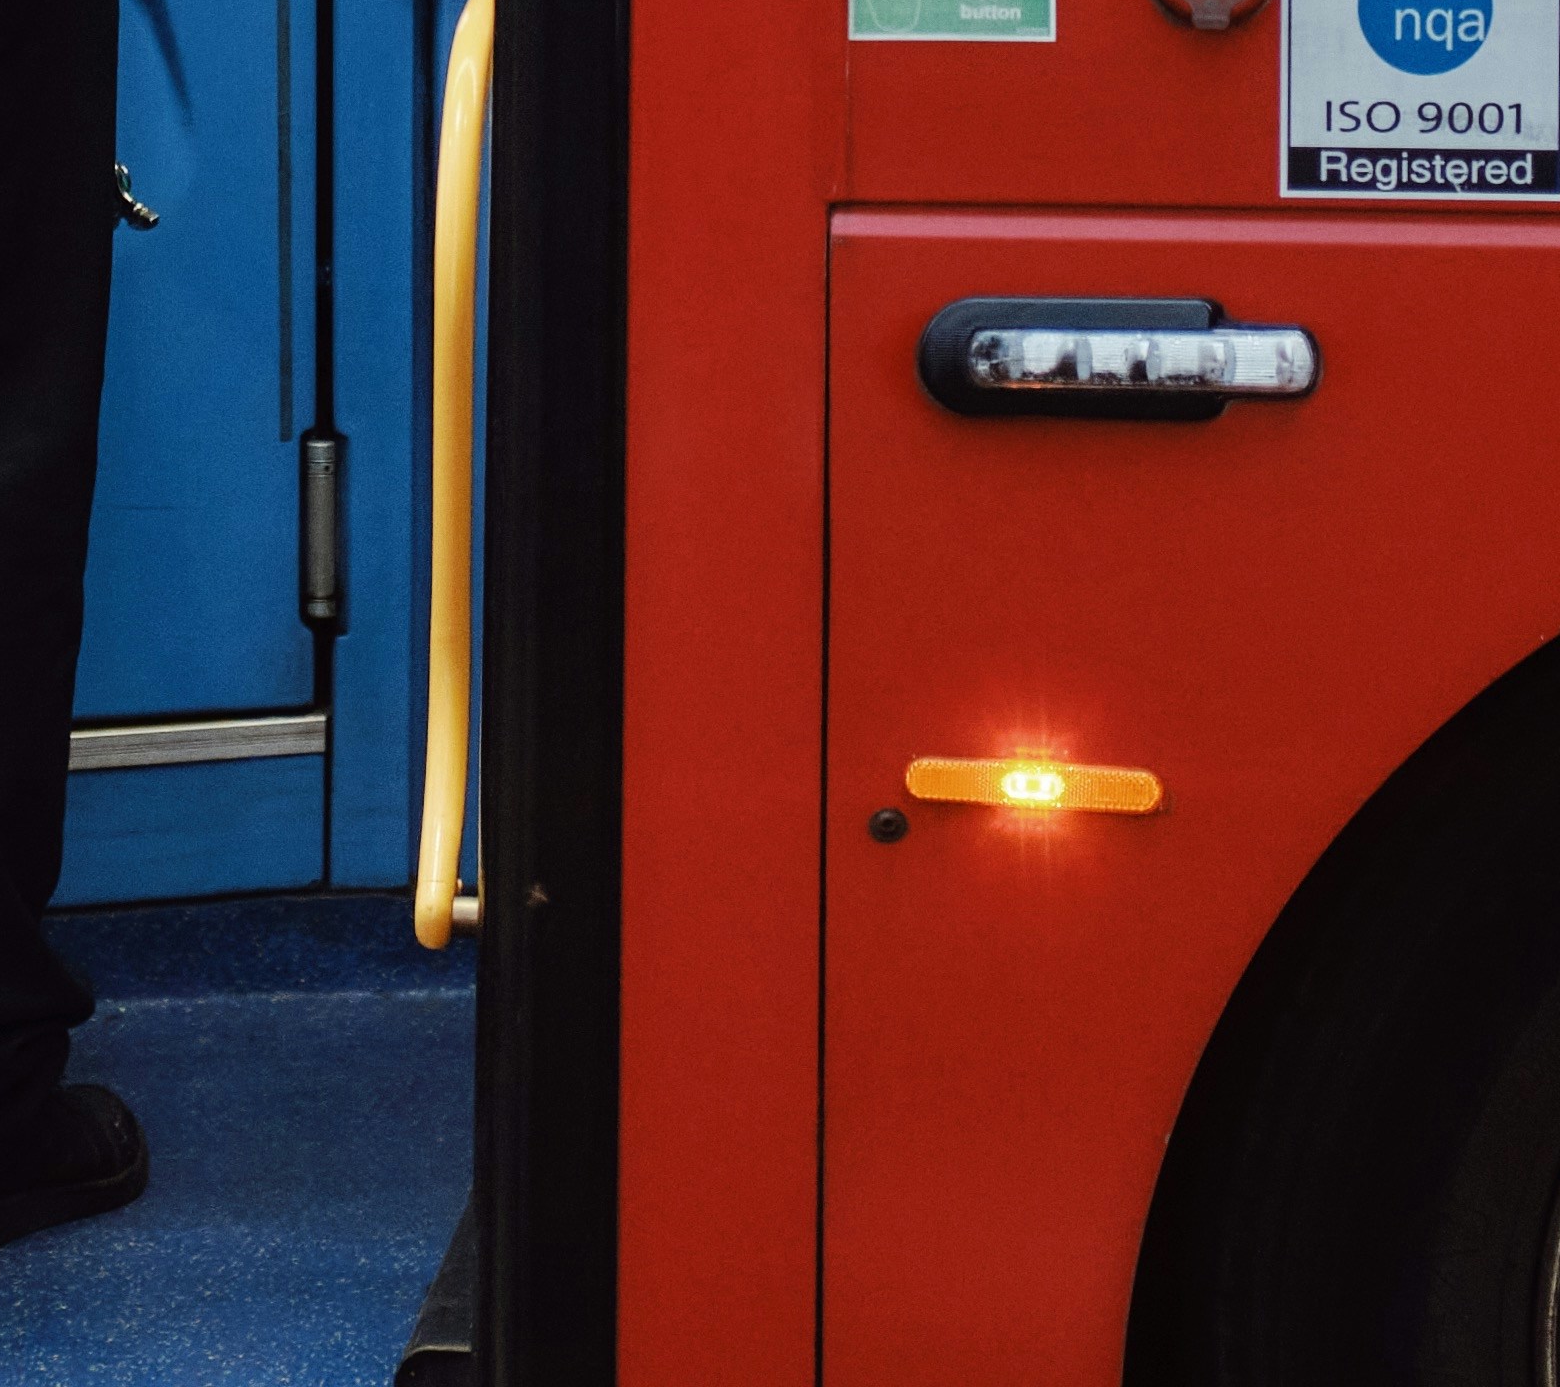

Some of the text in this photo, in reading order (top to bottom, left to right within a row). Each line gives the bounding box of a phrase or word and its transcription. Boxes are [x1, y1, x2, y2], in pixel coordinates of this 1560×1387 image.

[959, 3, 1022, 21] button
[1392, 4, 1488, 53] nqa
[1324, 99, 1524, 136] ISO 9001
[1318, 150, 1534, 192] Registered
